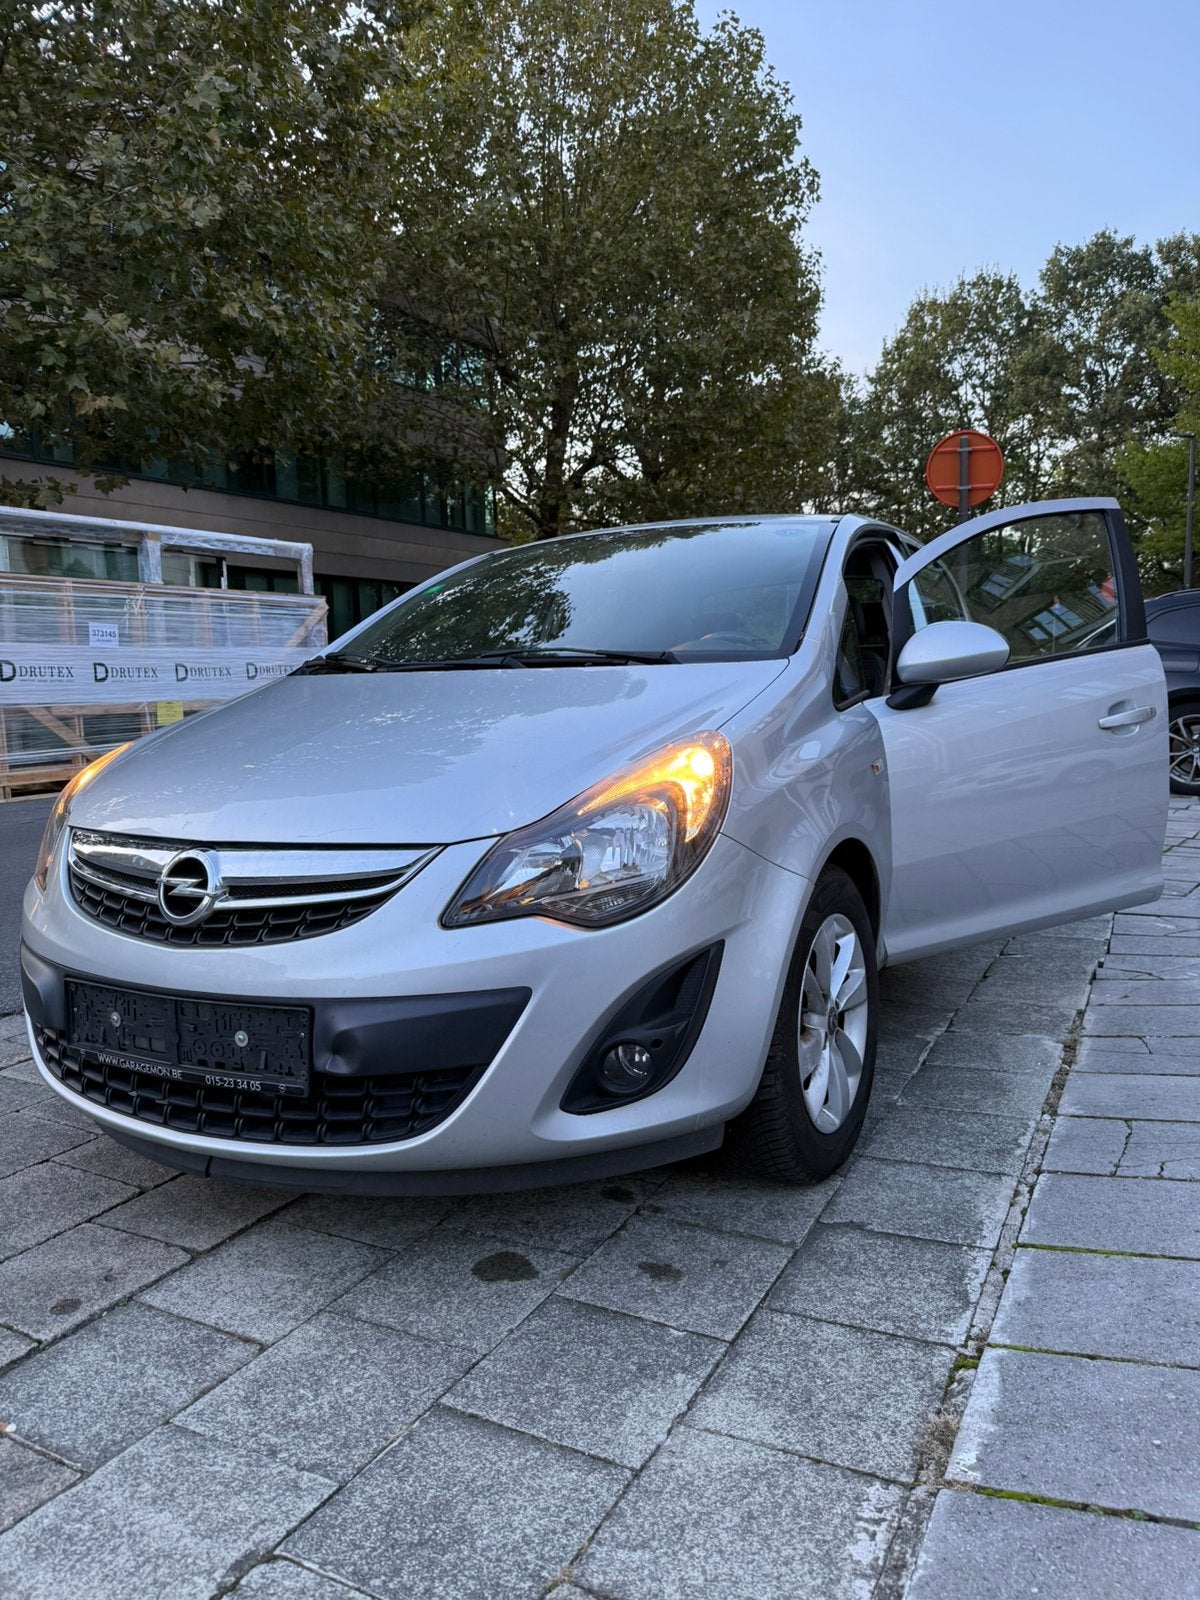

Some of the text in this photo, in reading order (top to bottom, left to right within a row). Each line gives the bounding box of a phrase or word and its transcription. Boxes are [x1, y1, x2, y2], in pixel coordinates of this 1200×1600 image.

[91, 629, 117, 638] 373145
[19, 665, 74, 678] DRUTEX
[110, 666, 159, 679] DRUTEX
[190, 666, 232, 677] DRUTEX
[97, 1052, 183, 1080] WWW.GARAGEMON.BE
[205, 1075, 262, 1091] 015-23 34 05
